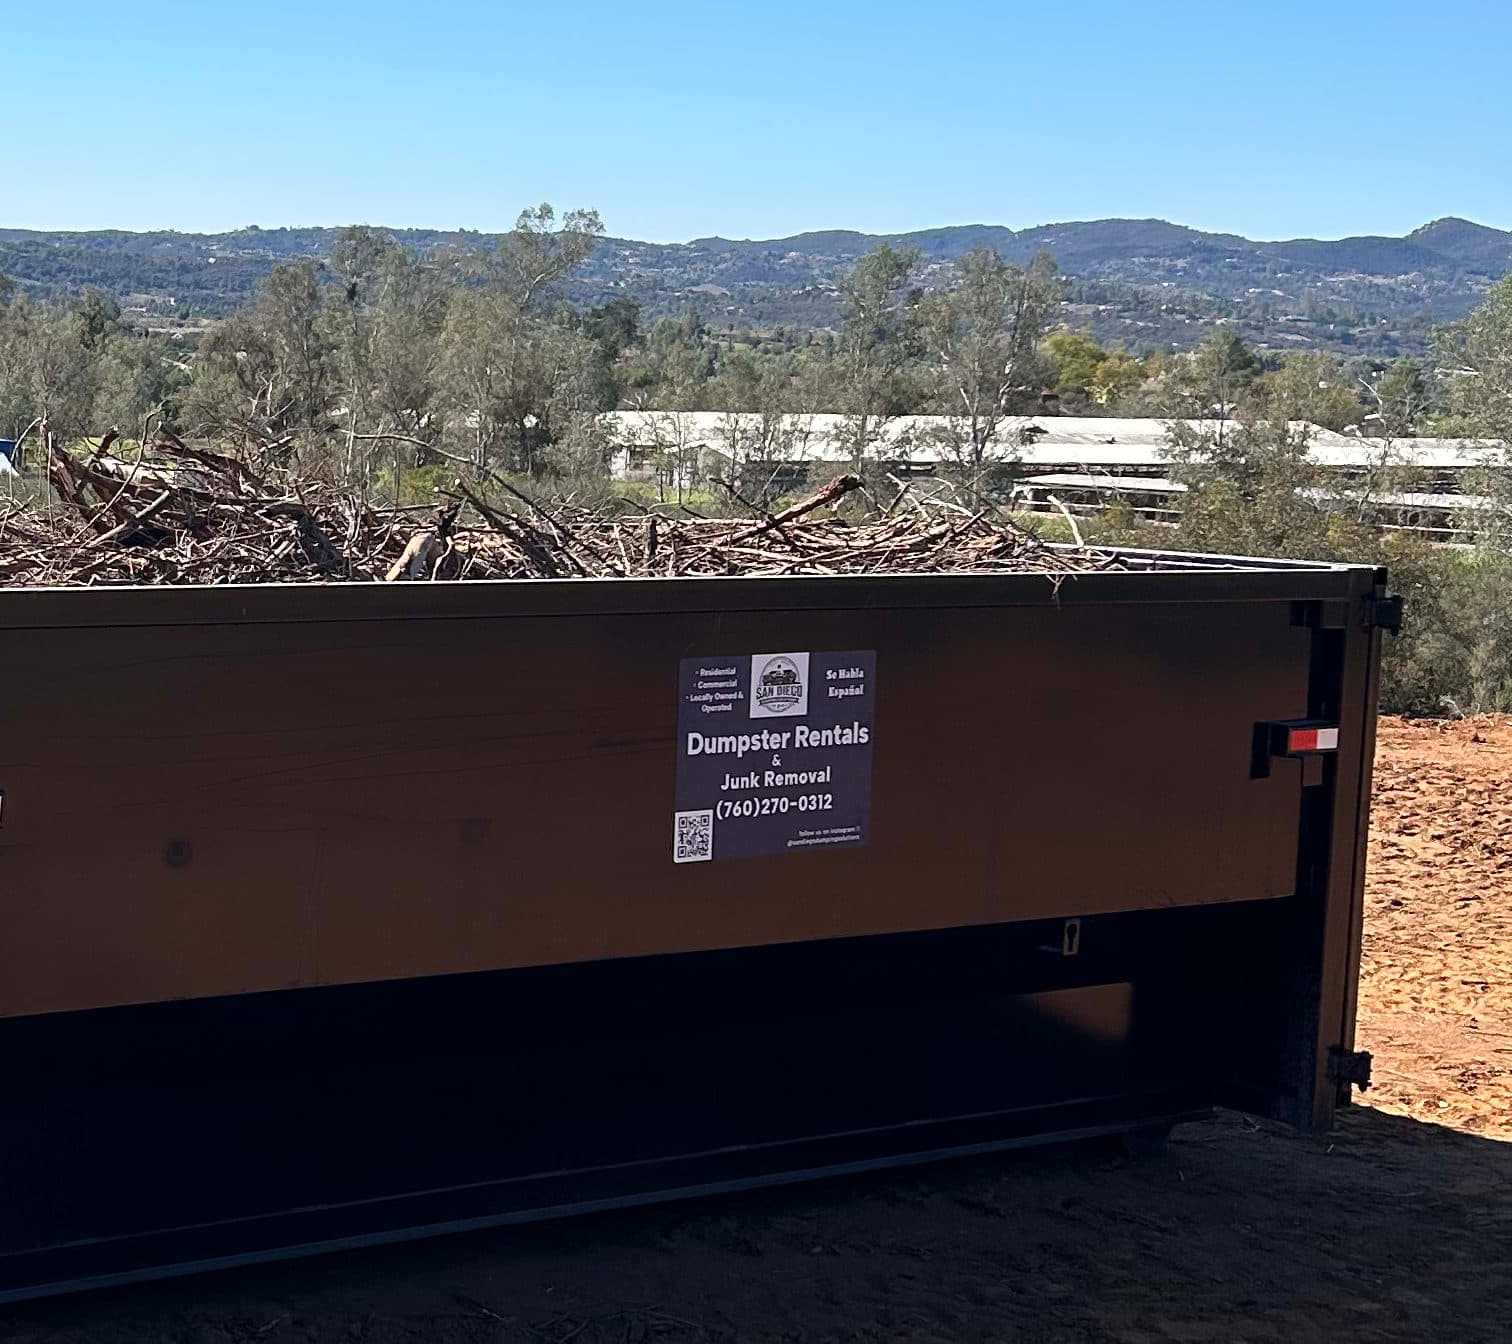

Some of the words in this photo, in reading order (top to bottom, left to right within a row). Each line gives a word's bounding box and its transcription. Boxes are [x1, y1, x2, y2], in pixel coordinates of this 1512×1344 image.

[838, 667, 864, 679] Habla
[756, 686, 774, 700] SAN
[777, 686, 803, 697] DIEGO
[828, 684, 864, 699] Español
[688, 729, 791, 758] Dumpster
[794, 721, 869, 749] Rentals
[771, 753, 782, 766] &
[720, 771, 760, 790] Junk
[764, 766, 831, 787] Removal
[716, 794, 833, 820] (760)270-0312
